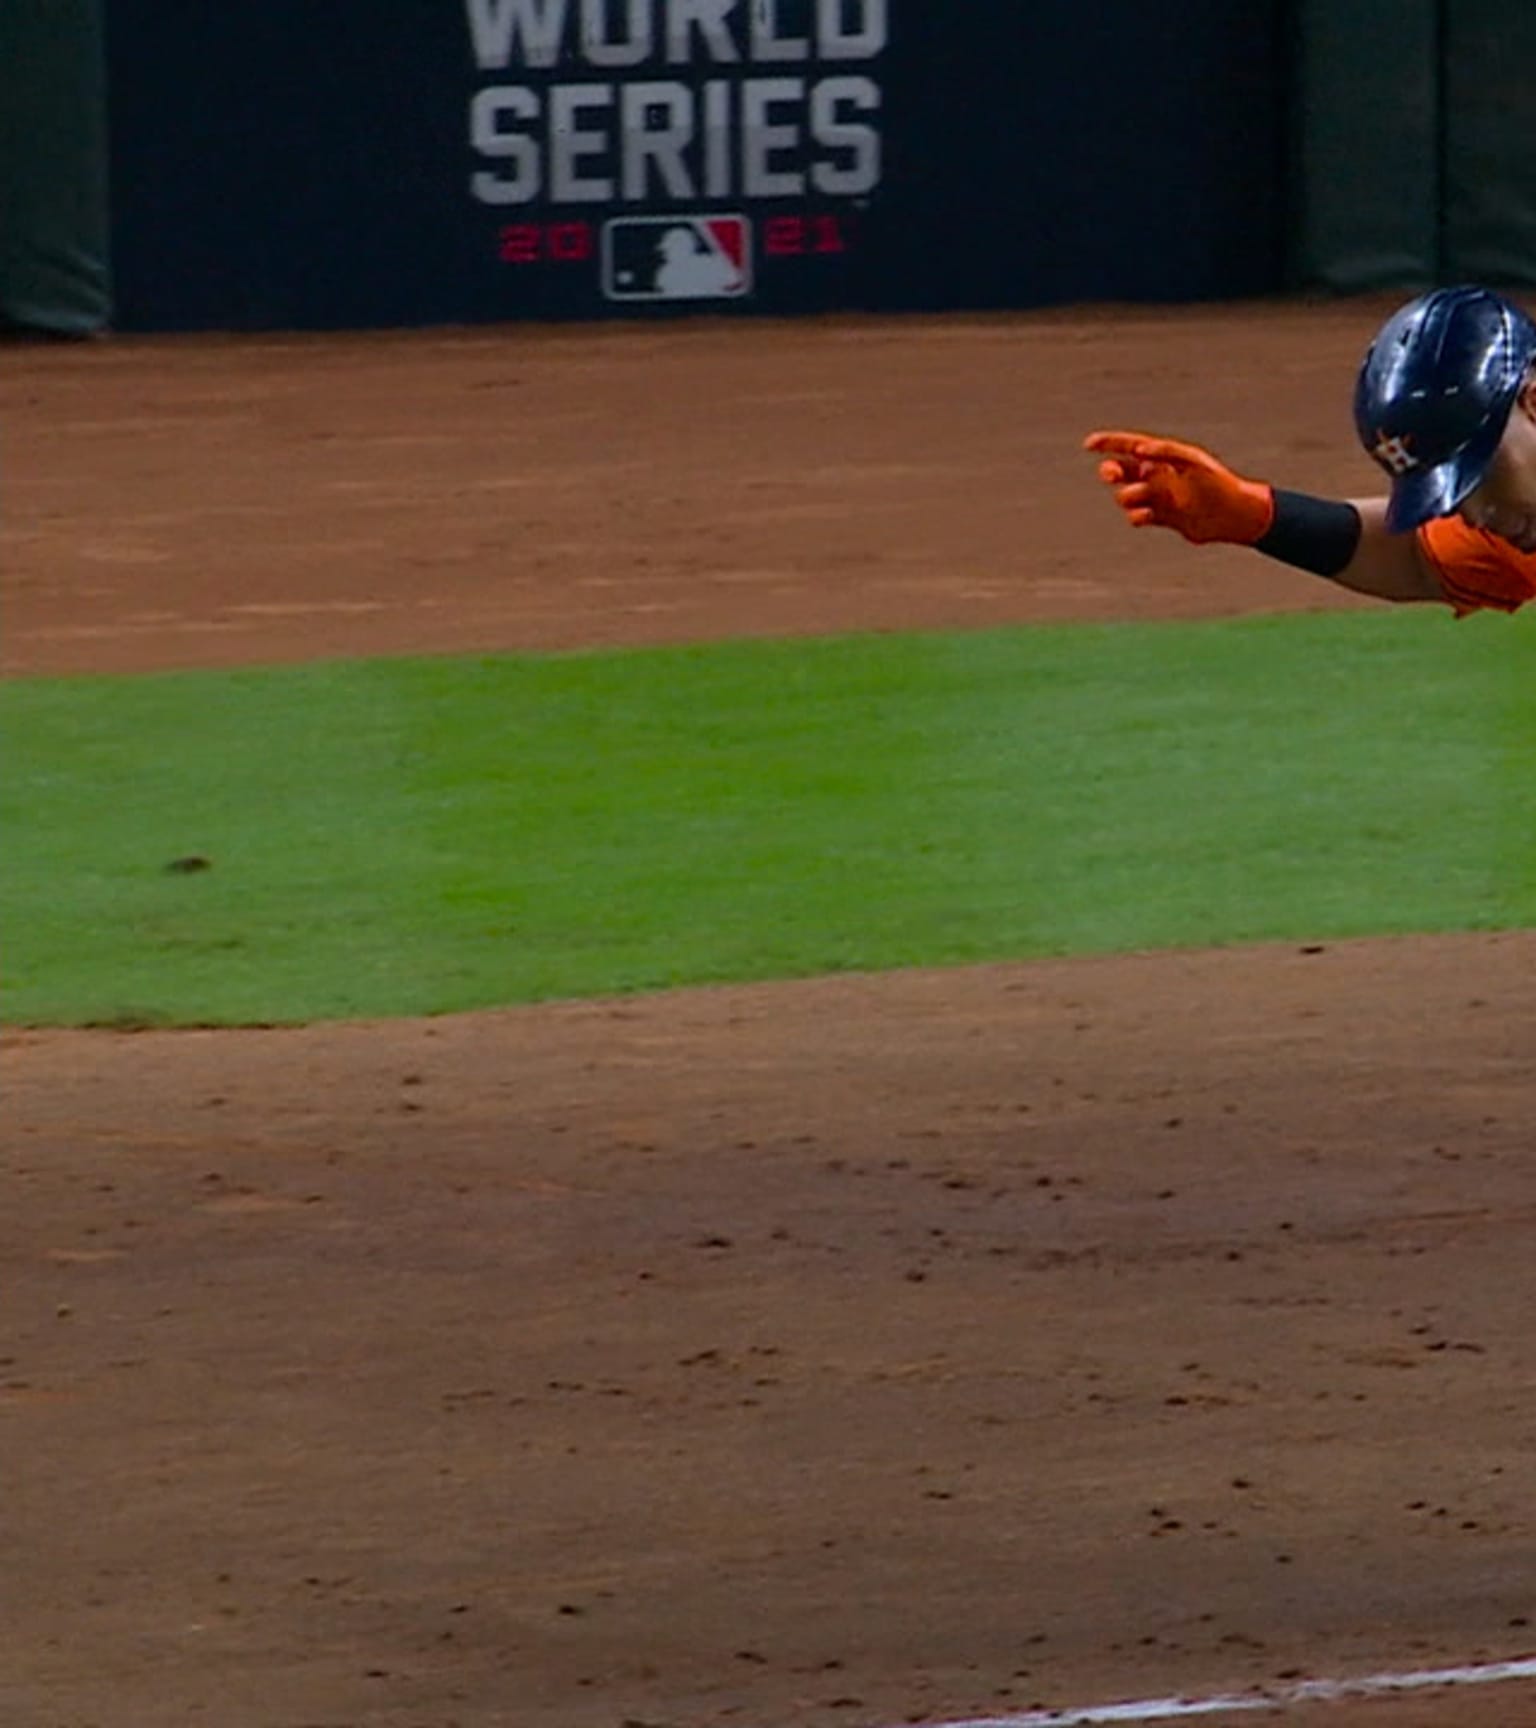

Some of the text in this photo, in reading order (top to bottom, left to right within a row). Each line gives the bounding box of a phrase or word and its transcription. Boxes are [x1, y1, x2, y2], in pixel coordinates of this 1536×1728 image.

[466, 0, 889, 69] WORLD
[469, 76, 881, 204] SERIES
[500, 216, 845, 263] 20 21
